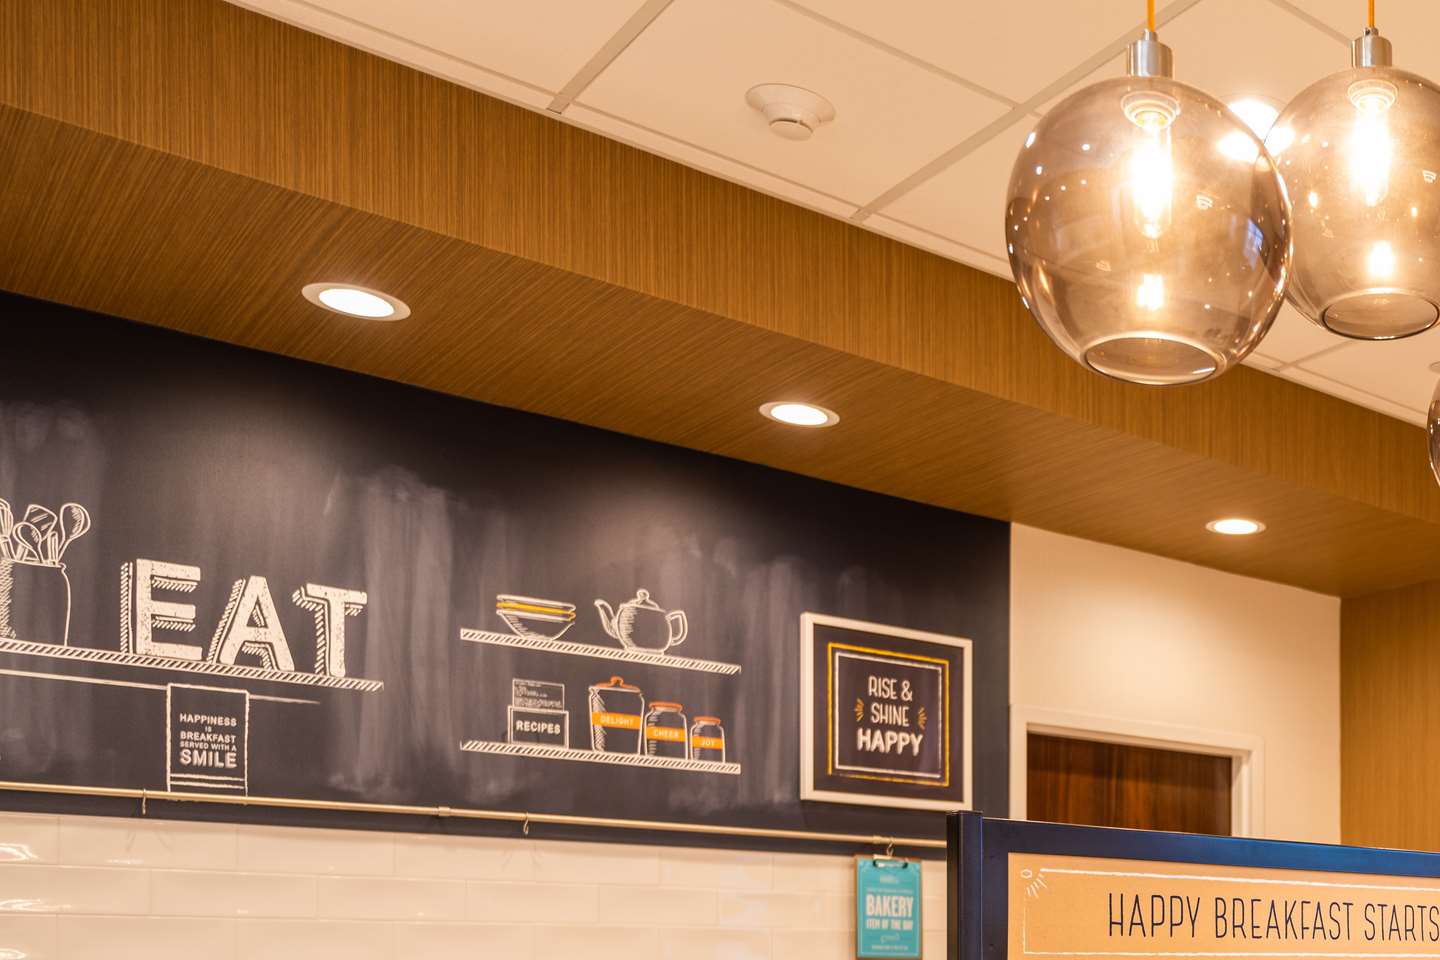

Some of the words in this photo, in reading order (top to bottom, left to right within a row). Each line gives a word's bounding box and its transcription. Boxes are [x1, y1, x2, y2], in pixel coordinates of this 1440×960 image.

[120, 558, 367, 678] EAT
[868, 675, 897, 699] RISE
[901, 680, 913, 701] &
[180, 712, 237, 727] HAPPINESS
[600, 715, 634, 725] DELIGHT
[871, 702, 909, 727] SHINE
[180, 731, 236, 743] BREAKFAST
[516, 720, 561, 734] RECIPES
[180, 741, 209, 749] SERVED
[211, 743, 230, 751] WITH
[857, 728, 923, 756] HAPPY
[180, 749, 237, 768] SMILE
[866, 894, 913, 918] BAKERY
[1108, 892, 1200, 938] HAPPY
[1215, 896, 1354, 941] BREAKFAST
[1364, 902, 1440, 943] STARTS
